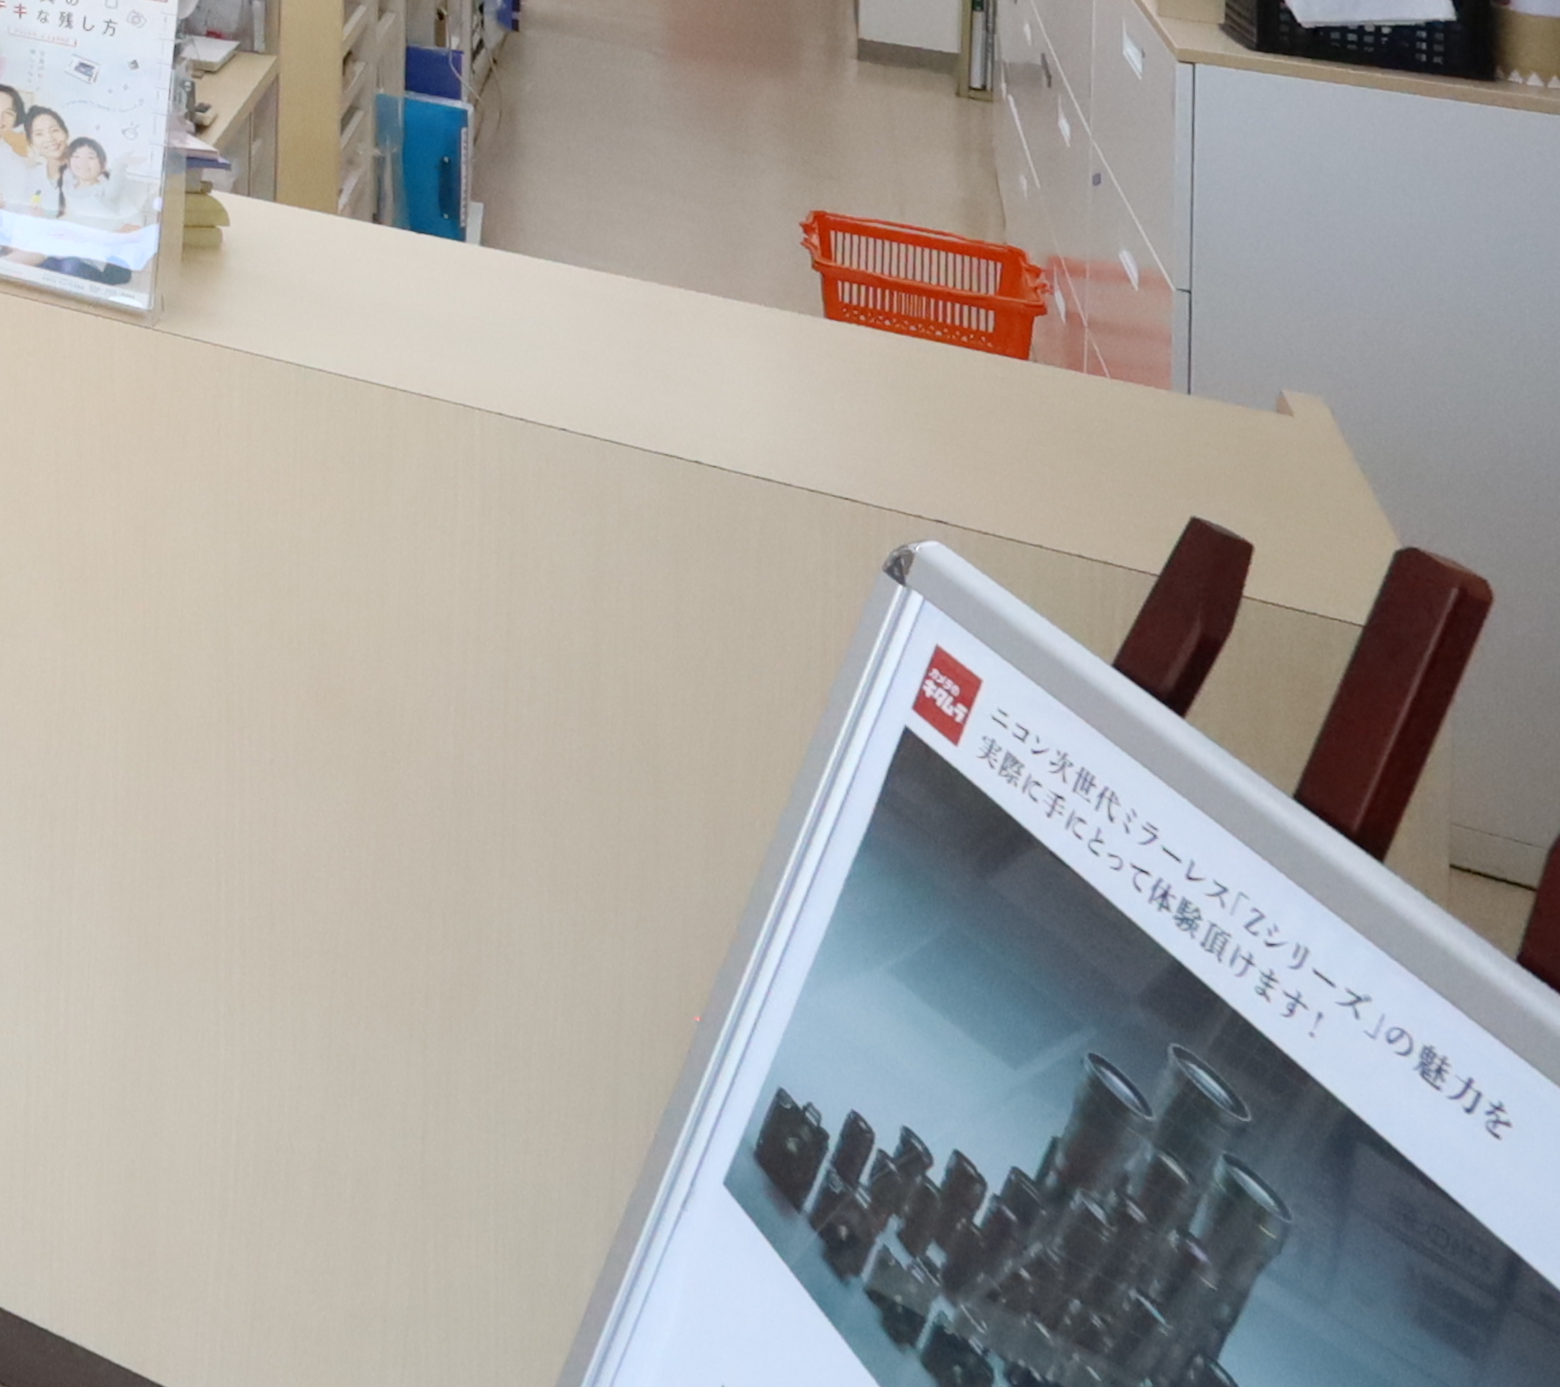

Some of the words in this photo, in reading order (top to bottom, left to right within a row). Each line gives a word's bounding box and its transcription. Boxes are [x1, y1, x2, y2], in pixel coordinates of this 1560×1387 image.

[920, 680, 968, 725] キタムラ
[928, 666, 961, 697] カメラの
[977, 733, 1325, 1039] 実際に手にとって体験頂けます!
[989, 707, 1514, 1141] ニコン次世代ミラーレス「Zシリーズ」の魅力を
